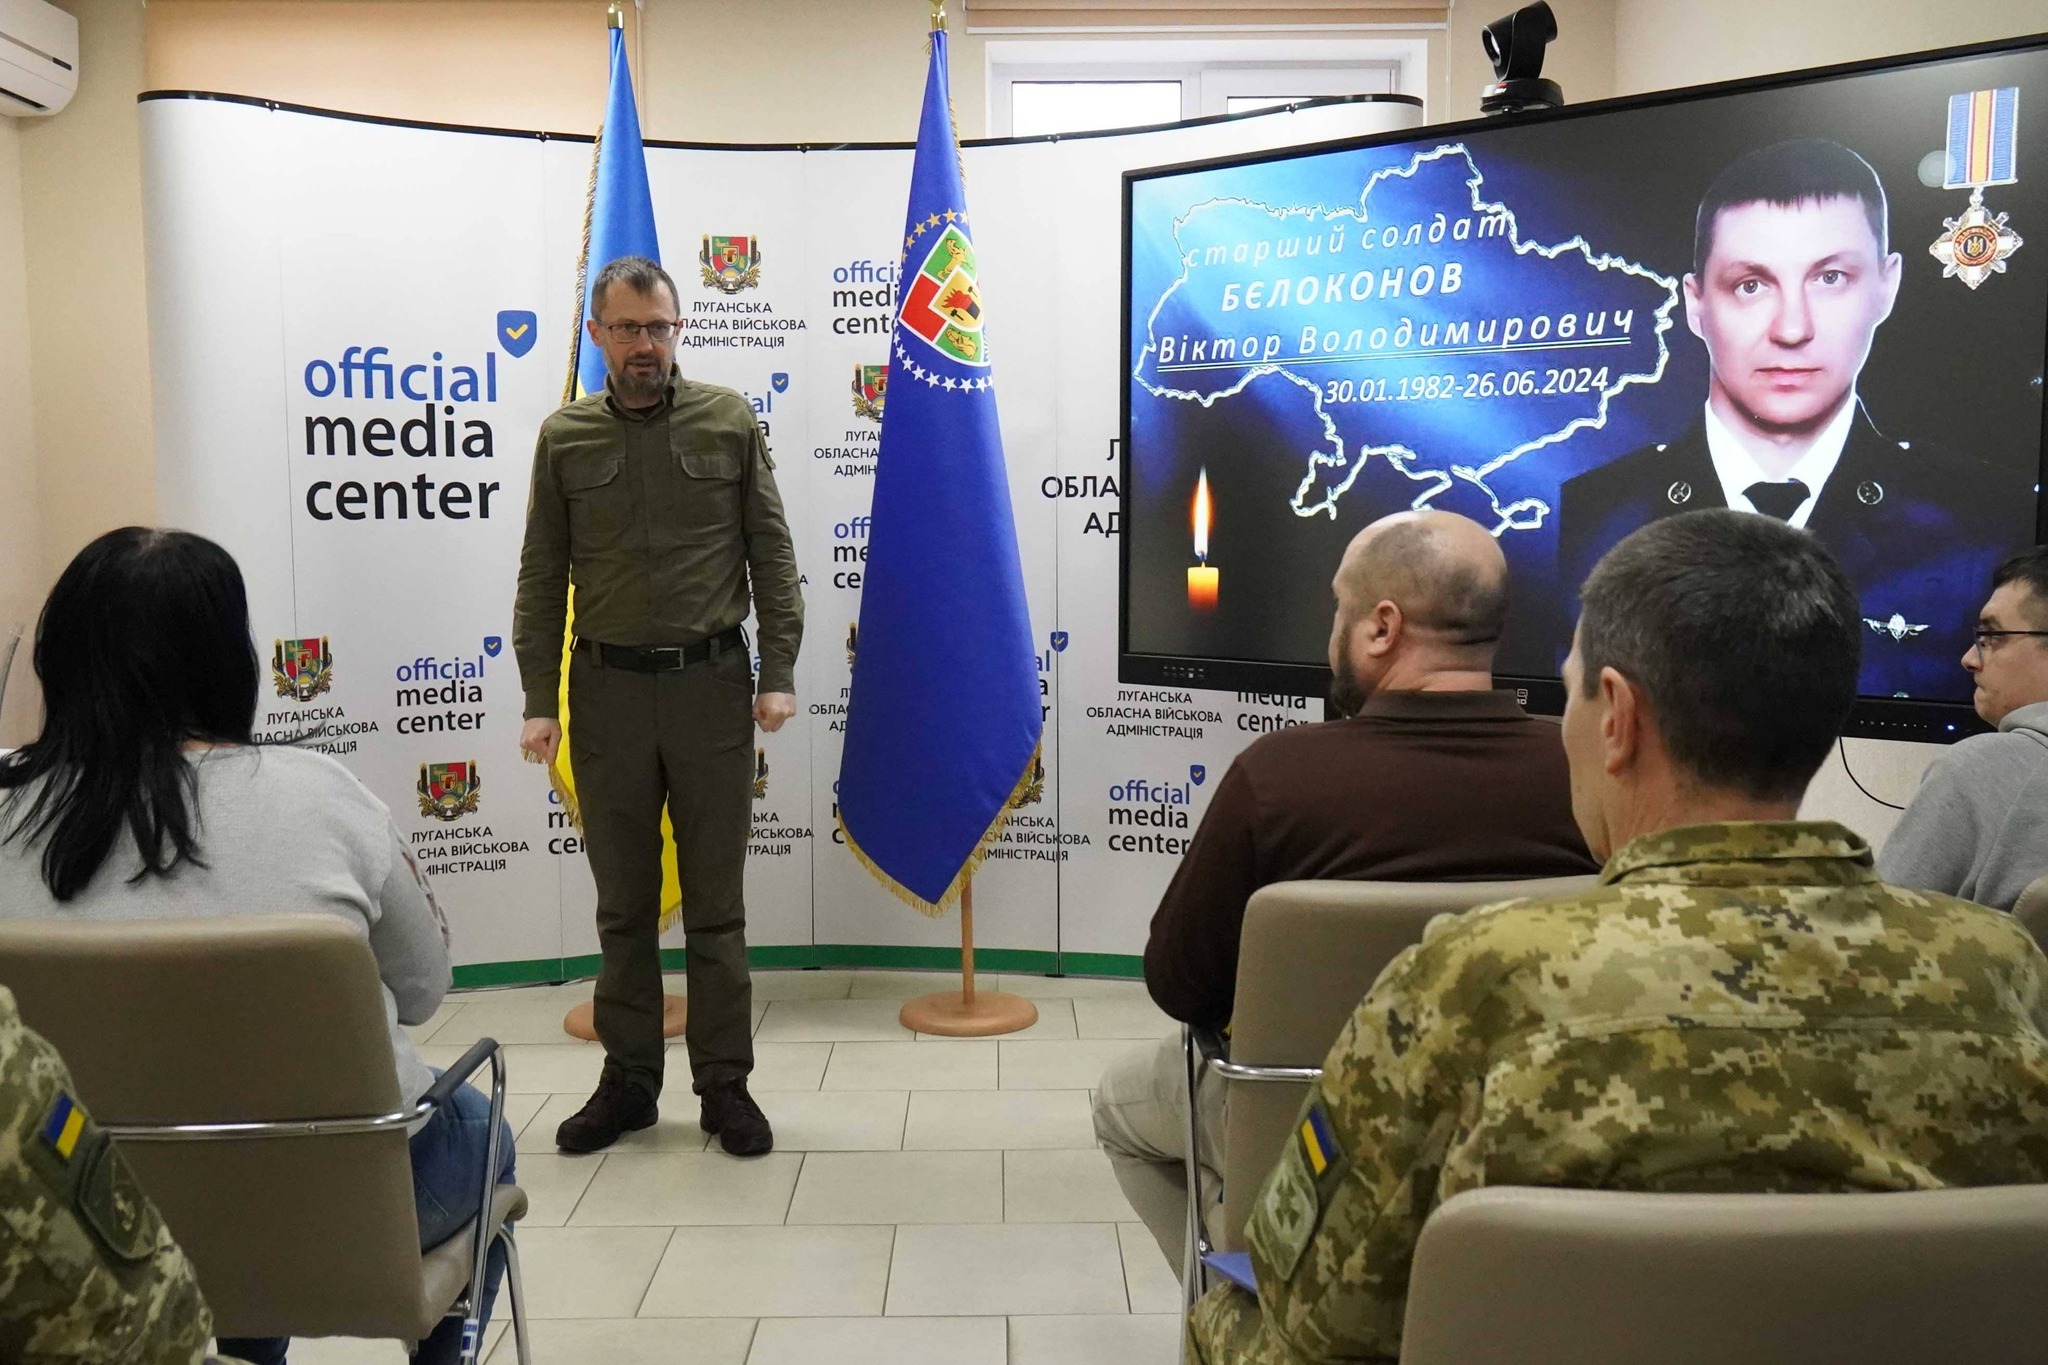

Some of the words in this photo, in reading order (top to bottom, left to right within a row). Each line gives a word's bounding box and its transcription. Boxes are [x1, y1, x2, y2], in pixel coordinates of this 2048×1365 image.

[1187, 224, 1345, 268] старший
[1361, 213, 1507, 250] солдат
[833, 260, 901, 283] offici
[833, 283, 899, 307] medi
[1221, 262, 1463, 312] БЄЛОКОНОВ
[692, 301, 773, 314] ЛУГАНСЬКА
[732, 317, 807, 331] ВІЙСЬКОВА
[832, 313, 895, 335] cent
[682, 335, 785, 349] АДМІНІСТРАЦІЯ
[1158, 334, 1281, 364] Віктор
[1299, 309, 1633, 354] Володимирович
[304, 346, 497, 402] official
[1325, 366, 1609, 404] 30.01.1982-26.06.2024
[305, 403, 494, 458] media
[306, 473, 500, 521] center
[1041, 476, 1120, 498] ОБЛА
[396, 655, 484, 682] official
[396, 680, 482, 707] media
[1117, 691, 1192, 703] ЛУГАНСЬКА
[266, 706, 345, 725] ЛУГАНСЬКА
[809, 704, 849, 715] ОБЛА
[1086, 707, 1152, 719] ОБЛАСНА
[1155, 707, 1223, 723] ВІЙСЬКОВА
[396, 710, 486, 734] center
[1106, 724, 1203, 740] АДМІНІСТРАЦІЯ
[1109, 780, 1190, 805] official
[1109, 803, 1188, 829] media
[411, 826, 493, 844] ЛУГАНСЬКА
[751, 826, 814, 839] ЙСЬКОВА
[451, 841, 530, 857] ВІЙСЬКОВА
[1108, 833, 1190, 855] center
